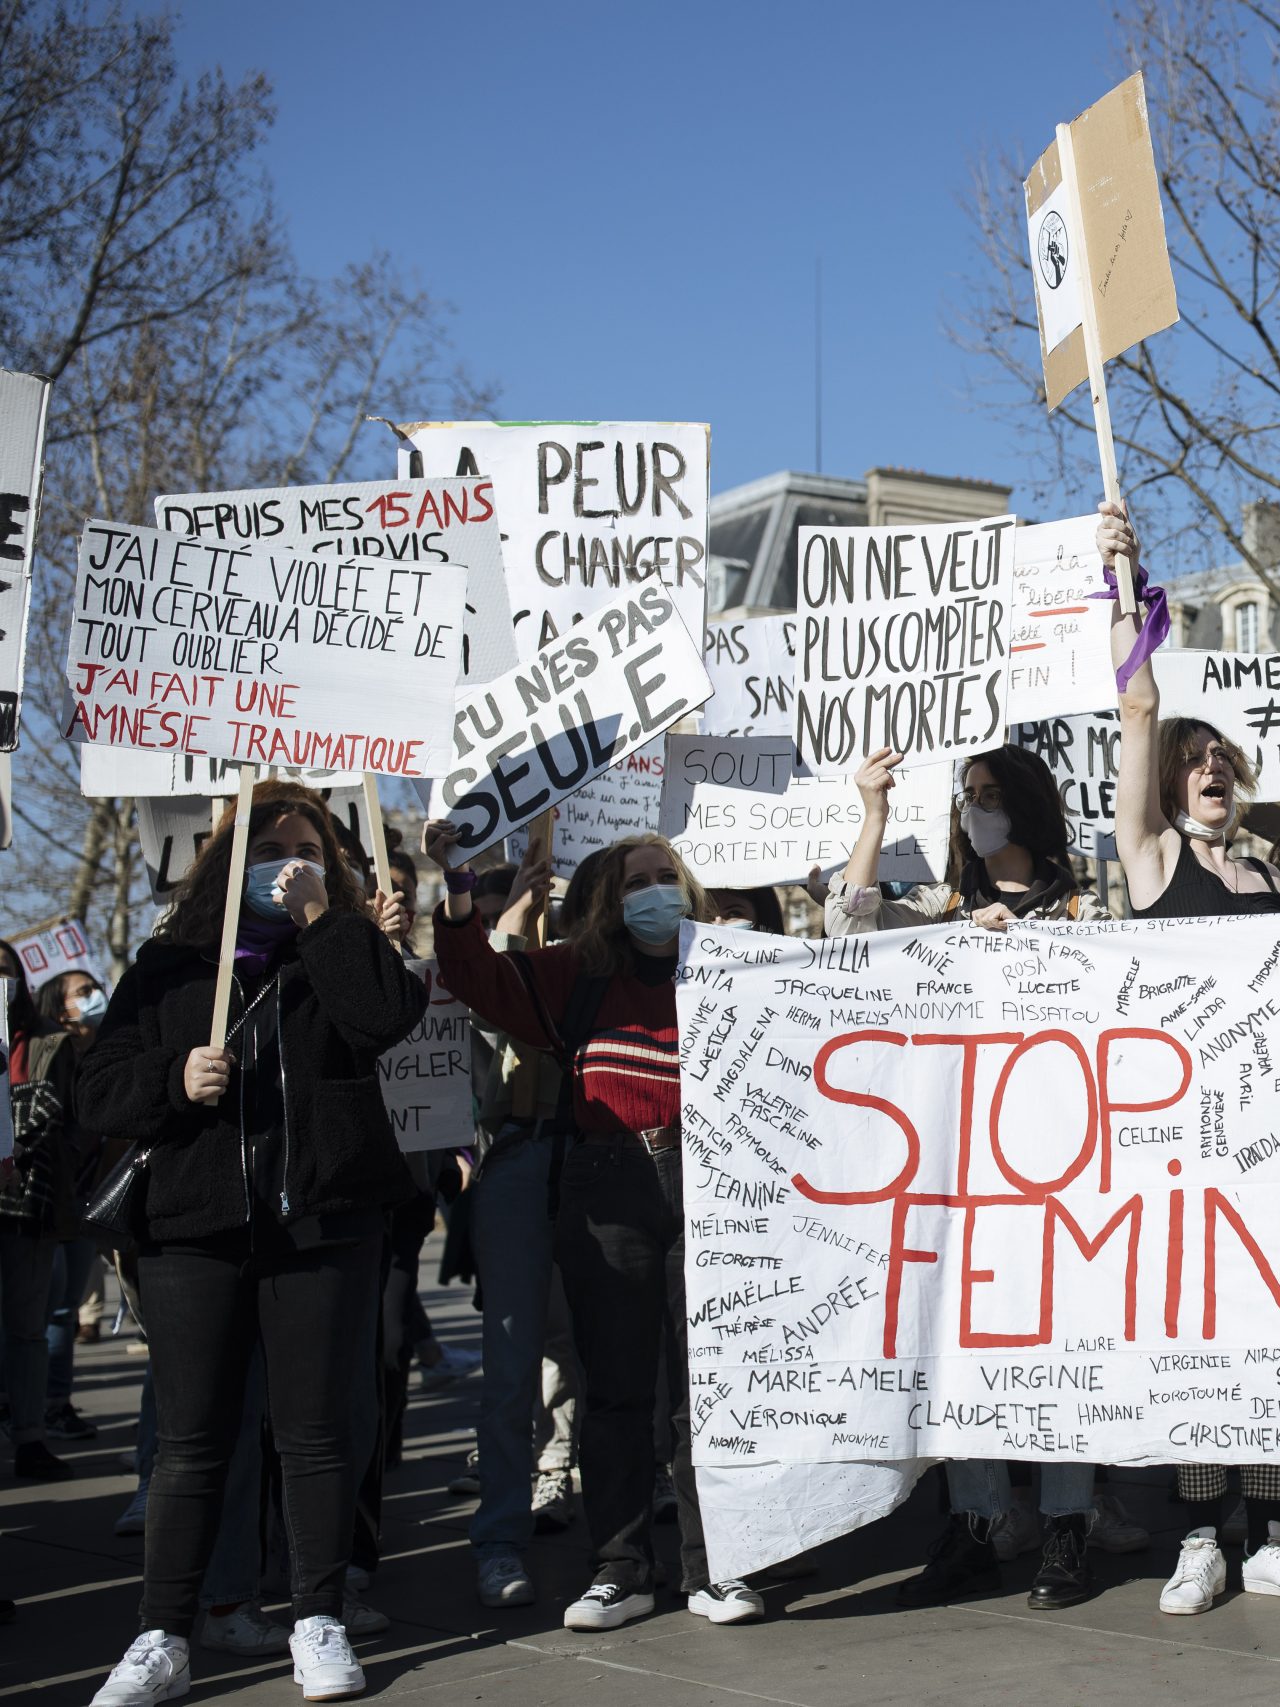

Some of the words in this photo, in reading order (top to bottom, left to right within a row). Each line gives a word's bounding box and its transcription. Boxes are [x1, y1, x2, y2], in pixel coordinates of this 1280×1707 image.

[537, 440, 693, 519] PEUR
[164, 500, 284, 539] DEPUIS
[300, 497, 364, 533] MES
[416, 482, 494, 529] ANS
[88, 527, 158, 580] J'AI
[170, 537, 253, 597] ÉTÉ
[270, 556, 375, 613] VIOLÉE
[385, 569, 431, 616] ET
[535, 531, 705, 588] CHANGER
[802, 534, 854, 608] ON
[865, 534, 917, 602] NE
[920, 520, 1015, 595] VEUT
[82, 575, 144, 620] MON
[152, 587, 279, 642] CERVEAU
[284, 608, 300, 644] A
[313, 608, 406, 653] DÉCIDÉ
[413, 625, 453, 659] DE
[1054, 621, 1081, 643] qui
[77, 619, 158, 663] TOUT
[803, 615, 881, 682] PLUS
[885, 597, 1005, 673] COMPTER
[452, 693, 504, 760] TU
[515, 637, 599, 718] N'ES
[599, 587, 673, 659] PAS
[76, 663, 138, 696] J'AI
[150, 673, 224, 706] FAIT
[235, 680, 302, 719] UNE
[65, 700, 213, 755] AMNÉSIE
[227, 720, 425, 776] TRAUMATIQUE
[797, 688, 856, 766] NOS
[684, 804, 735, 830] MES
[749, 803, 861, 829] SOEURS
[677, 840, 798, 866] PORTENT
[806, 842, 830, 860] LE
[944, 936, 1040, 953] CATHERINE
[1048, 941, 1096, 975] KARINE
[1002, 956, 1047, 986] ROSA
[1018, 979, 1082, 995] LUCETTE
[1115, 956, 1141, 1017] MARCELLE
[774, 978, 893, 1002] JACQUELINE
[917, 982, 973, 997] FRANCE
[890, 1001, 985, 1020] ANONYME
[1184, 997, 1227, 1042] LINDA
[713, 1006, 780, 1102] MAGDALENA
[765, 1047, 812, 1082] DINA
[740, 1099, 823, 1150] PASCALINE
[791, 1027, 1193, 1206] STOP
[1118, 1126, 1184, 1148] CELINE
[792, 1215, 891, 1271] JENNIFER
[696, 1250, 784, 1270] GEORGETTE
[782, 1276, 880, 1345] ANDRÉE
[742, 1344, 814, 1364] MÉLISSA
[1065, 1337, 1117, 1352] LAURE
[980, 1365, 1104, 1391] VIRGINIE
[1149, 1354, 1232, 1374] VIRGINIE
[908, 1401, 1058, 1432] CLAUDETTE
[1078, 1403, 1145, 1425] HANANE
[708, 1436, 758, 1454] ANONYME
[832, 1433, 890, 1449] ANONYME
[1002, 1432, 1089, 1453] AURELIE
[1168, 1421, 1274, 1453] CHRISTINE
